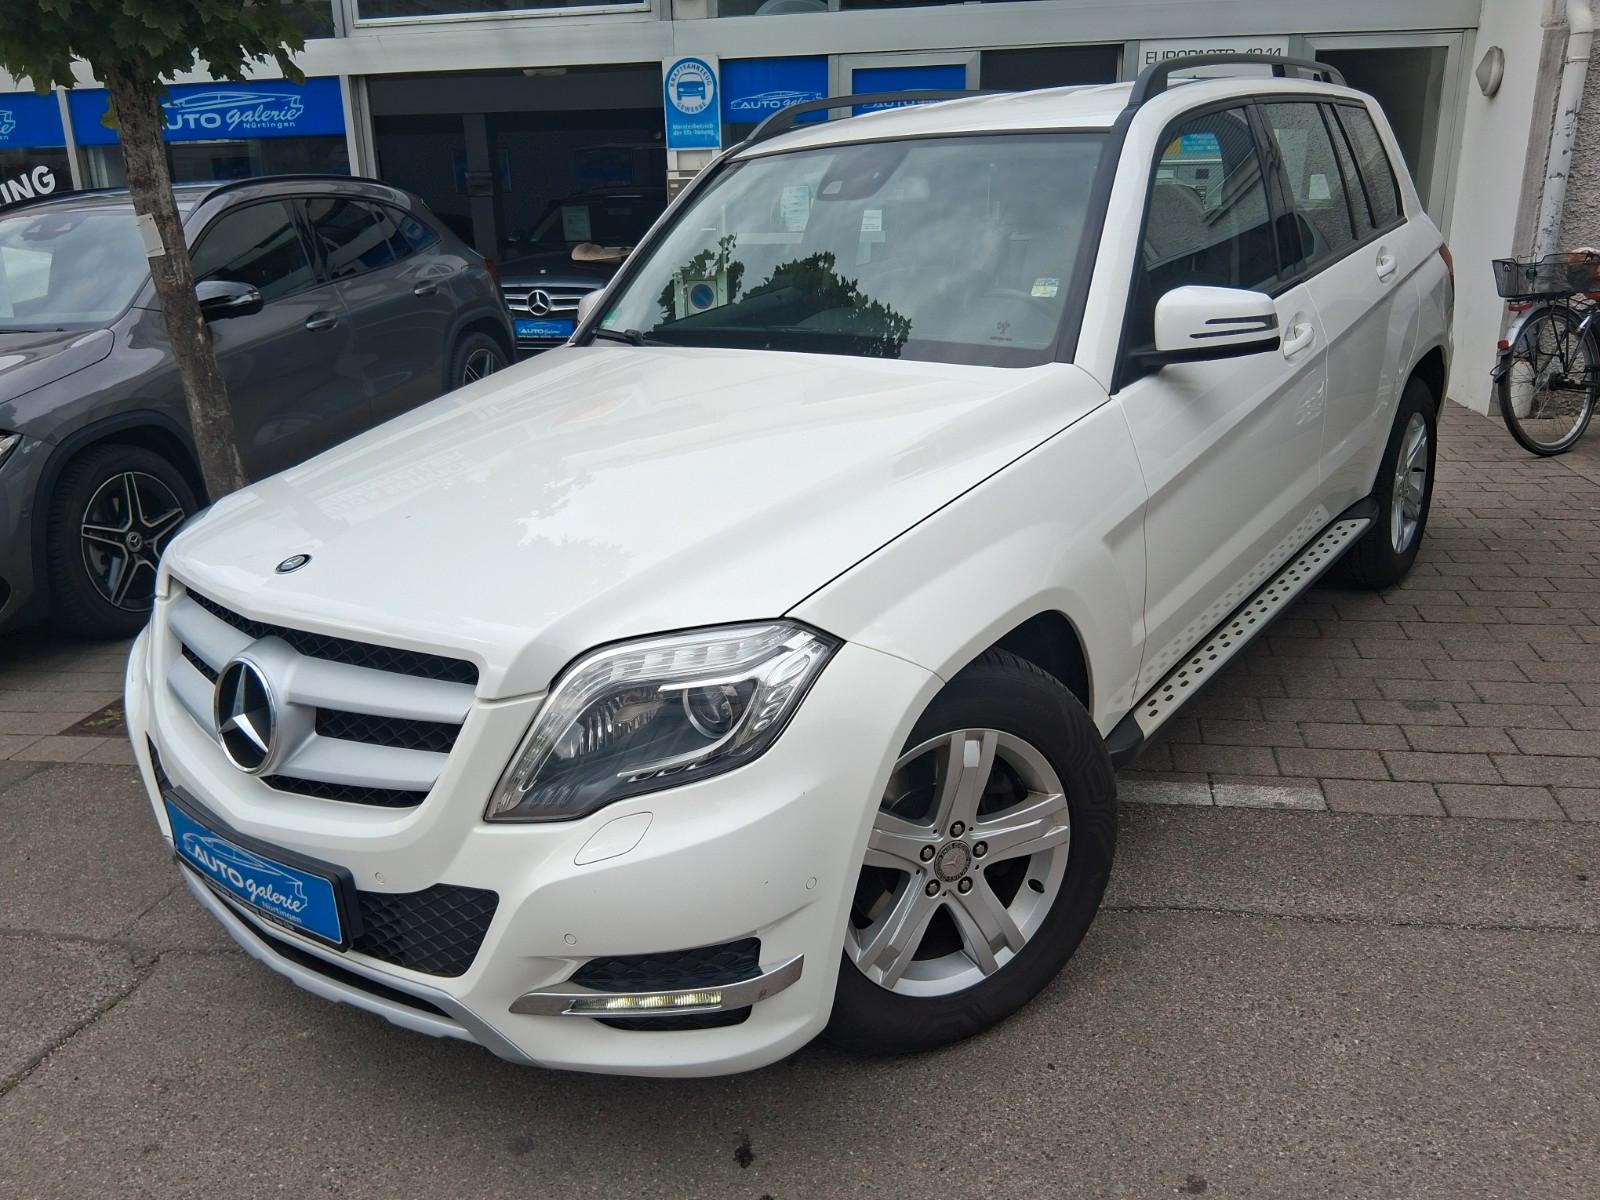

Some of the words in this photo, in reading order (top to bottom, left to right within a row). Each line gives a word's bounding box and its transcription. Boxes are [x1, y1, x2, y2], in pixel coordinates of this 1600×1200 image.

[669, 63, 713, 87] KRAFTFAHRZEUG
[678, 101, 708, 113] GEWERBE
[740, 101, 780, 109] AUTO
[161, 112, 221, 129] UTO
[226, 104, 299, 131] galerie
[243, 121, 296, 129] Nürtingen
[0, 165, 56, 206] ING
[194, 845, 244, 889] AUTO
[246, 878, 303, 912] galerie
